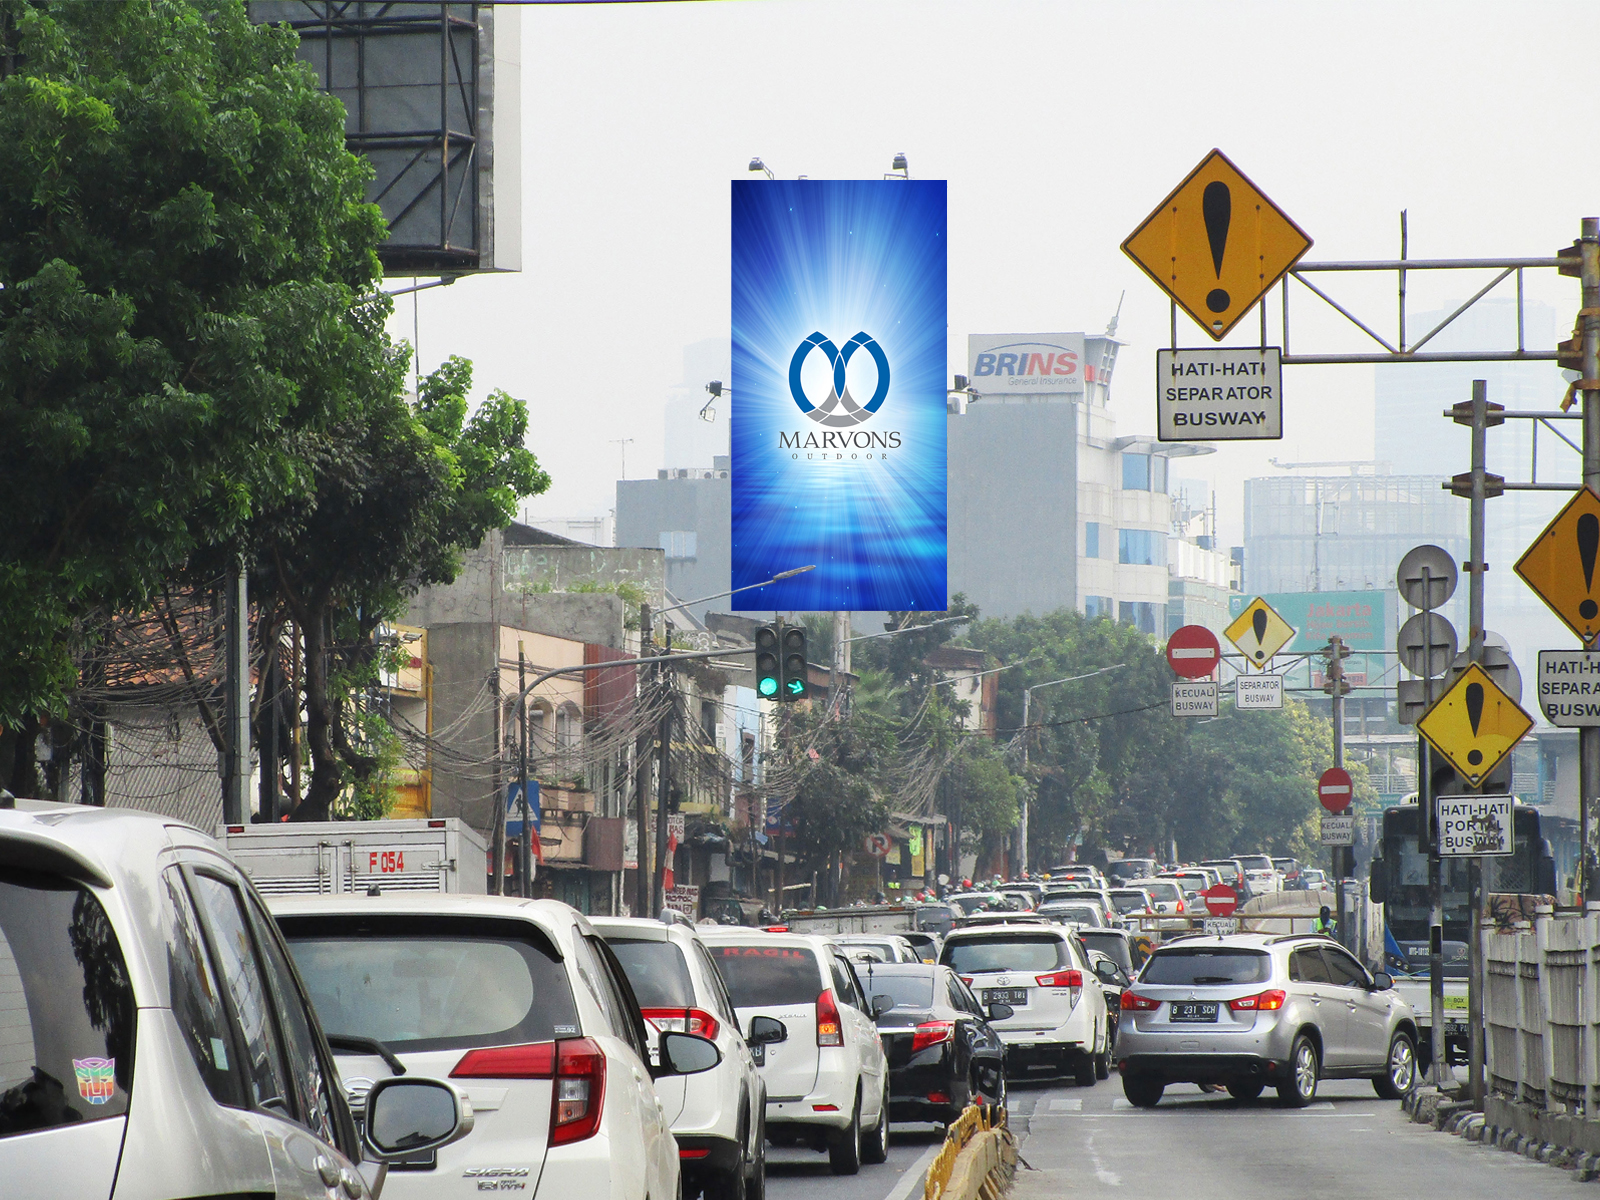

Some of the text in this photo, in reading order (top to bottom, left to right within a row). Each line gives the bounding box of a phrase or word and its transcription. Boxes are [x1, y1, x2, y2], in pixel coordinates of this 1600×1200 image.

[973, 353, 1078, 376] BRINS
[1171, 362, 1266, 376] HATI-HATI
[1008, 376, 1077, 386] General Insurance
[1166, 386, 1272, 401] SEPARATOR
[1173, 411, 1266, 426] BUSWAY
[778, 431, 902, 449] MARVONS
[1307, 602, 1372, 617] Jakarta
[1239, 681, 1280, 690] SEPARATOR
[1175, 688, 1215, 698] KECUALI
[1244, 694, 1275, 703] BUSWAY
[1175, 702, 1214, 711] BUSWAY
[1441, 803, 1509, 816] HATI-HATI
[1445, 819, 1504, 832] PORTAL
[1322, 832, 1351, 840] BUSWAY
[1445, 836, 1504, 850] BUSWAY
[369, 851, 404, 873] F 054
[723, 948, 805, 959] RAGIL
[983, 991, 989, 1000] B
[1172, 1005, 1216, 1015] B 231 SCH
[462, 1167, 530, 1178] SIGRA
